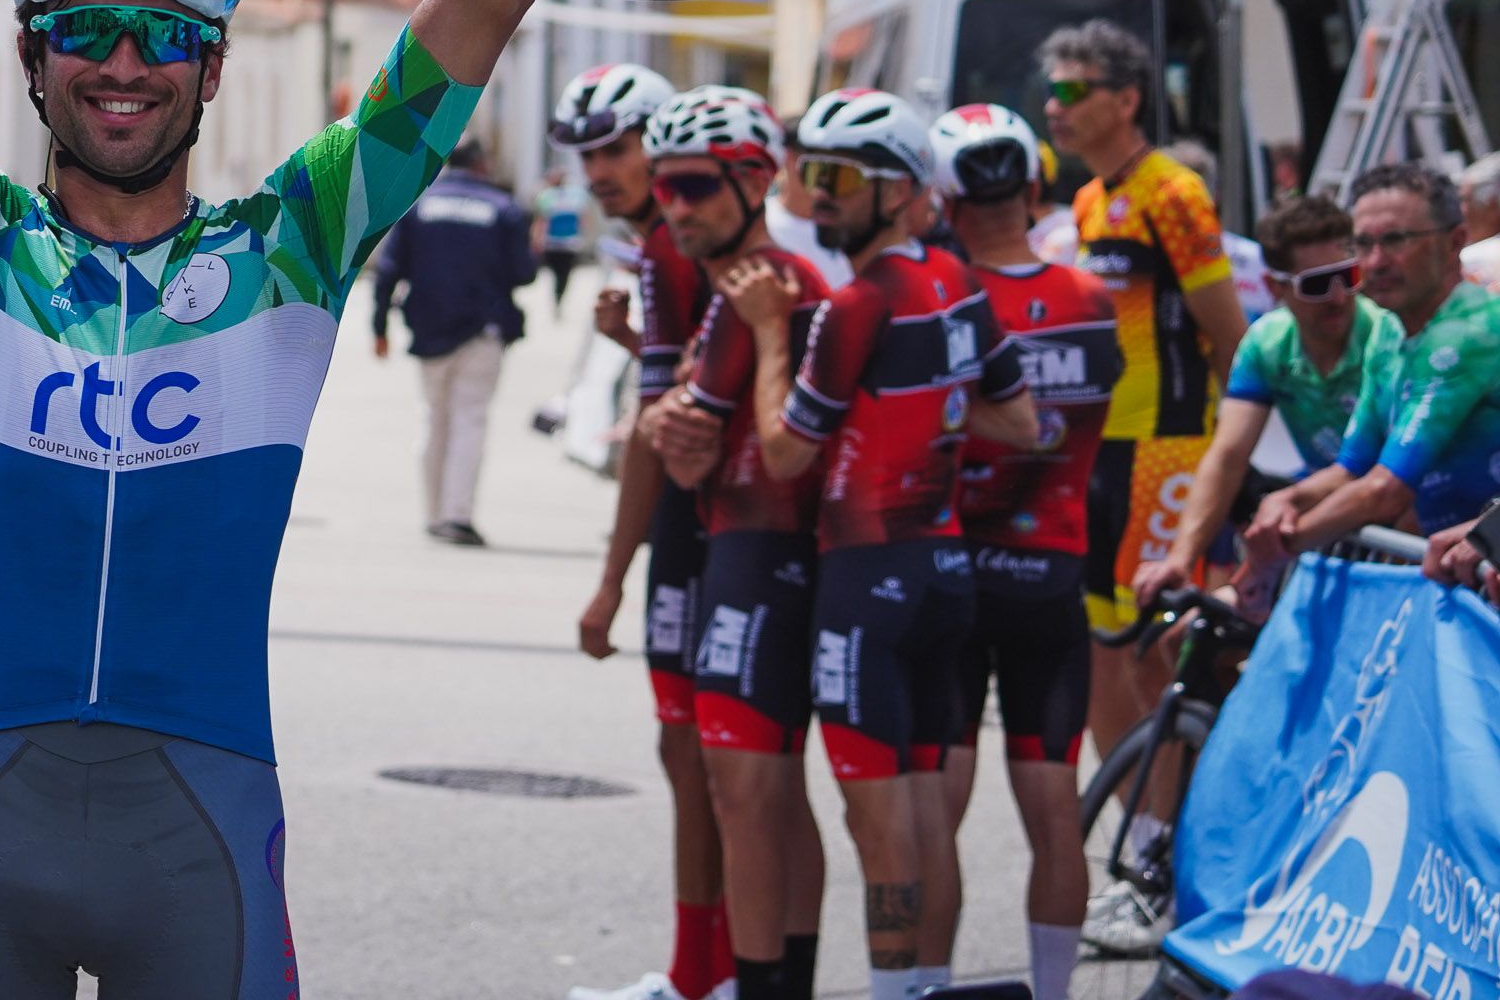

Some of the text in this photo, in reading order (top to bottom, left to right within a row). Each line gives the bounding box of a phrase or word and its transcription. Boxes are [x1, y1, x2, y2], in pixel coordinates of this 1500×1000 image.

[30, 361, 201, 451] rtc
[29, 436, 200, 467] COUPLING TECHNOLOGY
[1408, 842, 1500, 965] ASSOCIA
